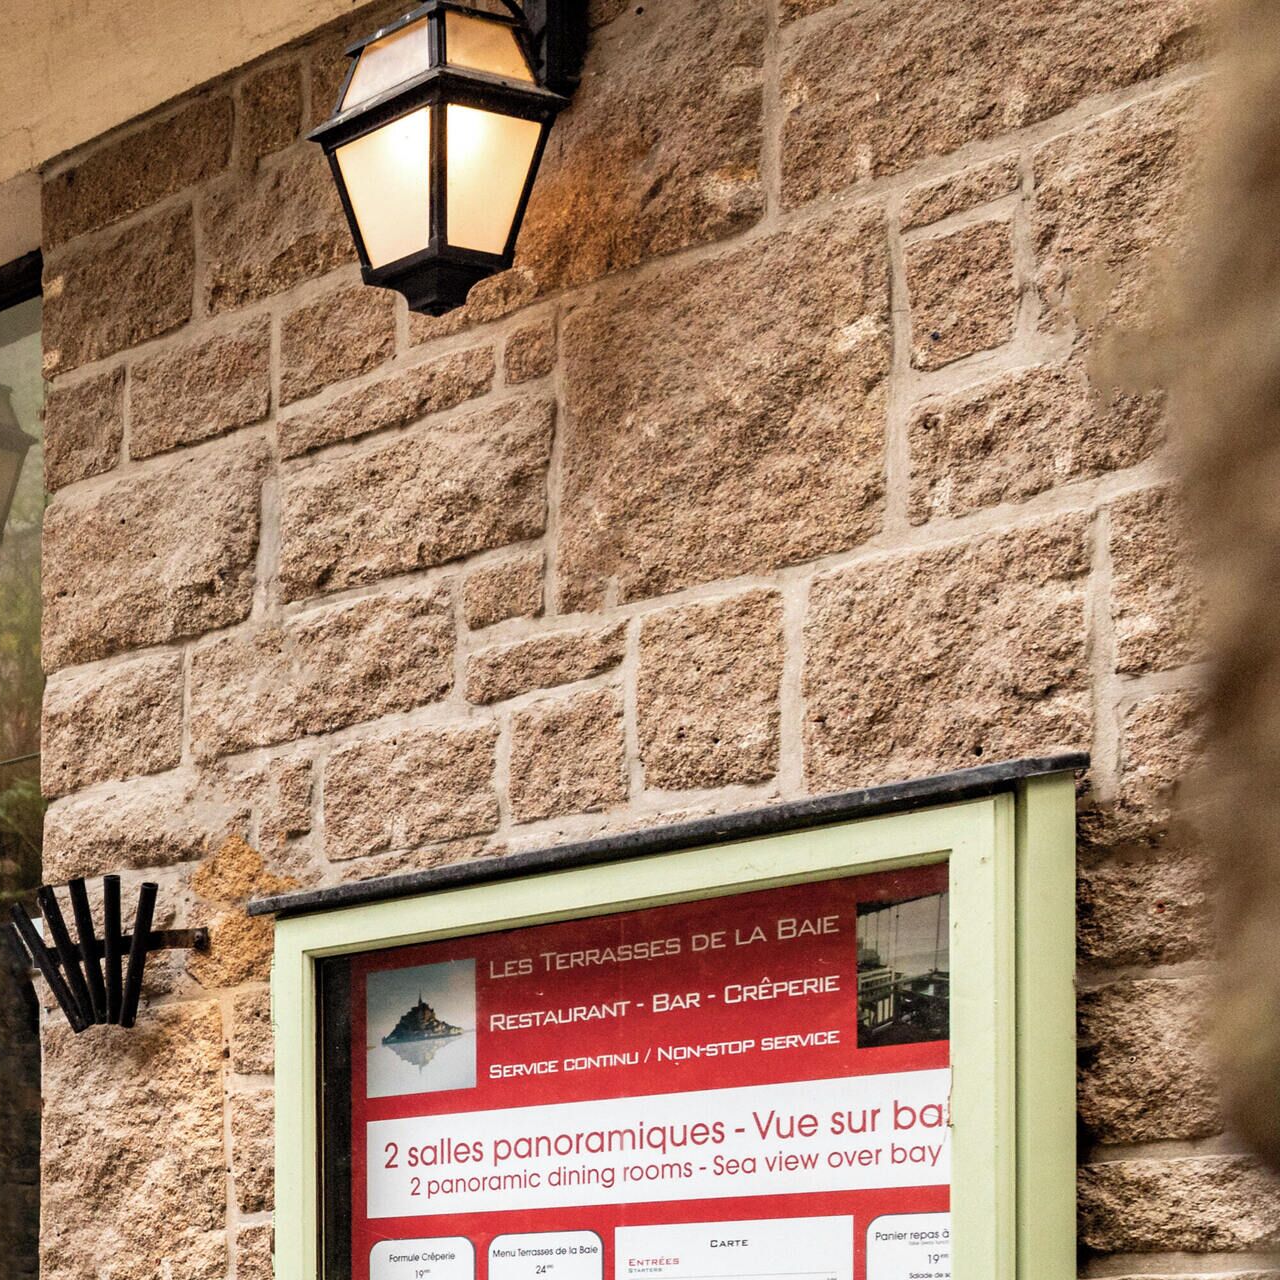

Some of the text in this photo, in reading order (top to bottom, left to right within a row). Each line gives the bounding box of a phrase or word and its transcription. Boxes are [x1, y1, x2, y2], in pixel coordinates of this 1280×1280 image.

[384, 1141, 398, 1169] 2
[407, 1137, 483, 1167] salles
[493, 1121, 725, 1165] panoramiques
[752, 1110, 818, 1140] Vue
[830, 1108, 880, 1135] sur
[894, 1100, 943, 1129] ba
[410, 1176, 420, 1196] 2
[427, 1169, 540, 1198] panoramic
[547, 1164, 614, 1188] dining
[623, 1161, 693, 1181] rooms
[713, 1154, 756, 1176] Sea
[764, 1151, 819, 1172] view
[827, 1148, 882, 1168] over
[890, 1143, 942, 1166] bay
[875, 1228, 947, 1240] Panier repas à
[709, 1239, 748, 1248] CARTE
[388, 1252, 455, 1262] Formule Crêperie
[492, 1245, 598, 1257] Menu Terrasses de la Baie
